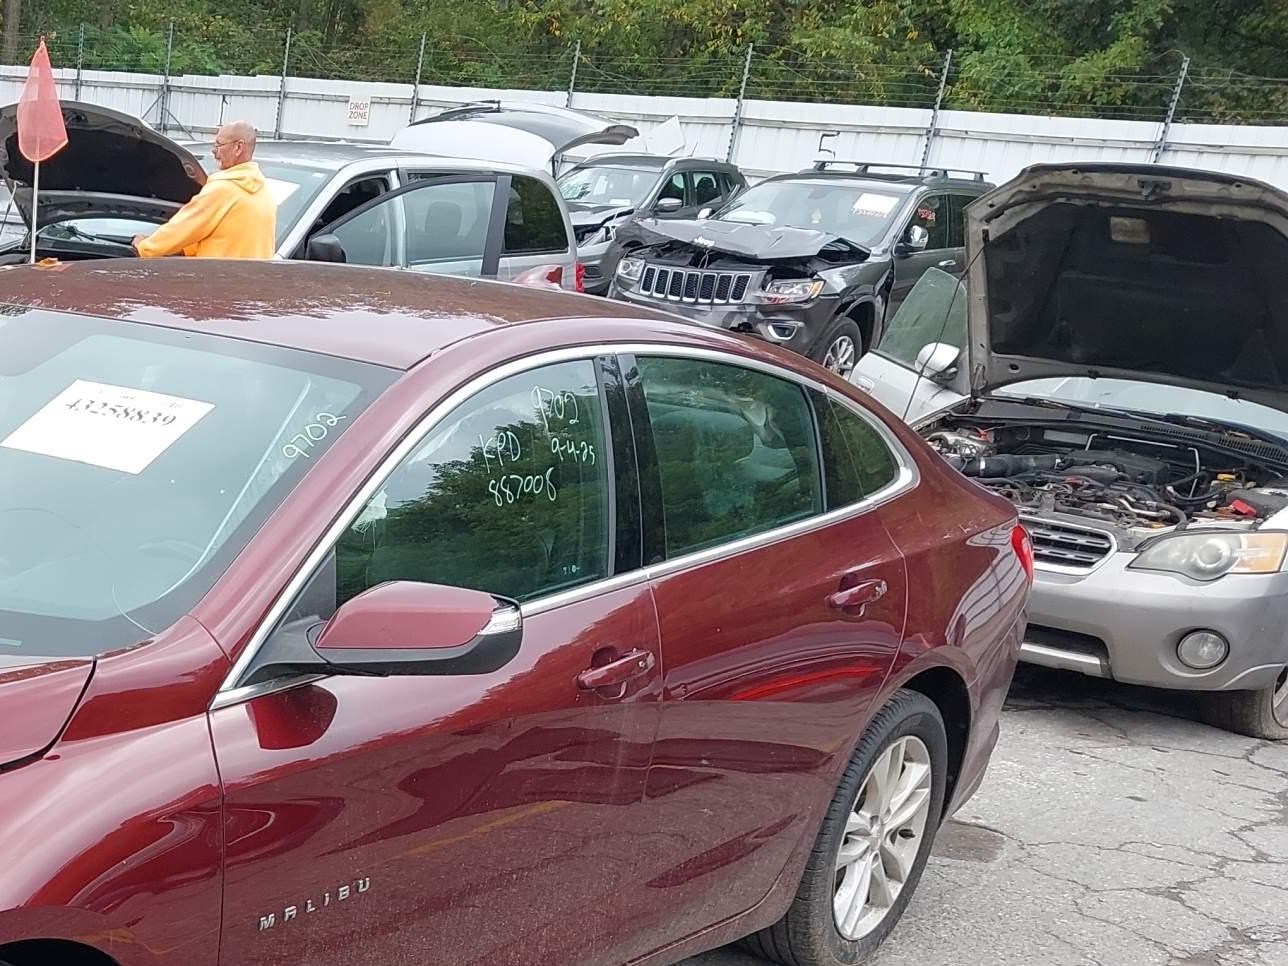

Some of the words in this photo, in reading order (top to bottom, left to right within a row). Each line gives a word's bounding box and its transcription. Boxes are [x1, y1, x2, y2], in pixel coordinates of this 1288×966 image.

[349, 102, 369, 111] DROP
[349, 110, 368, 120] ZONE
[65, 398, 177, 426] 43258839
[282, 412, 347, 458] 9702
[479, 430, 521, 474] KPD
[258, 877, 371, 931] MALIBU
